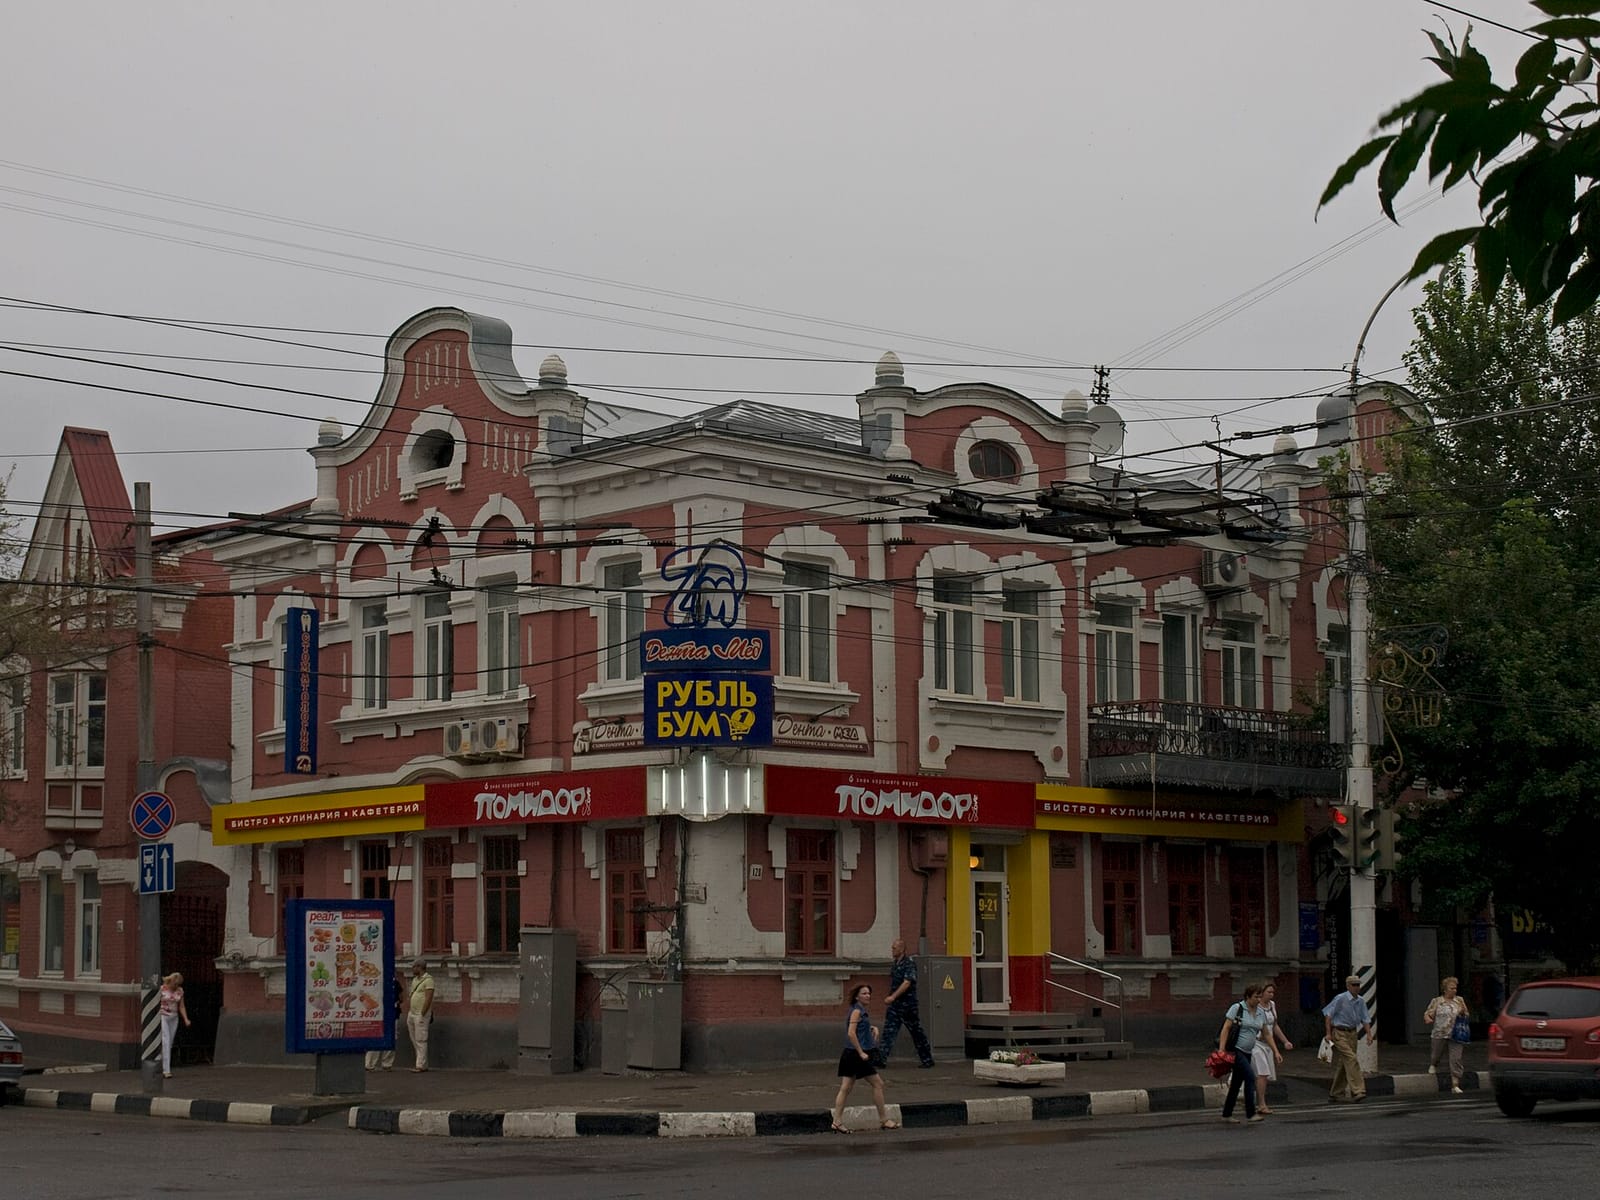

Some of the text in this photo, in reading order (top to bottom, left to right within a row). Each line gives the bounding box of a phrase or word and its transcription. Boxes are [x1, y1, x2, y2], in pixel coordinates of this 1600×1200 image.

[645, 636, 764, 662] Дента Мед
[299, 631, 311, 753] СТОМАТОЛОГИЯ
[657, 680, 758, 708] РУБЛЬ
[657, 710, 722, 738] БУМ
[776, 714, 826, 738] Дента
[231, 802, 420, 828] БИСТРО КУЛИНАРИЯ КАФЕТЕРИЙ
[473, 786, 586, 820] ПОМИДОР
[834, 784, 972, 820] ПОМИДОР
[1043, 803, 1270, 824] БИСТРО КУЛИНАРИЯ КАФЕТЕРИЙ
[978, 898, 998, 912] 9-21
